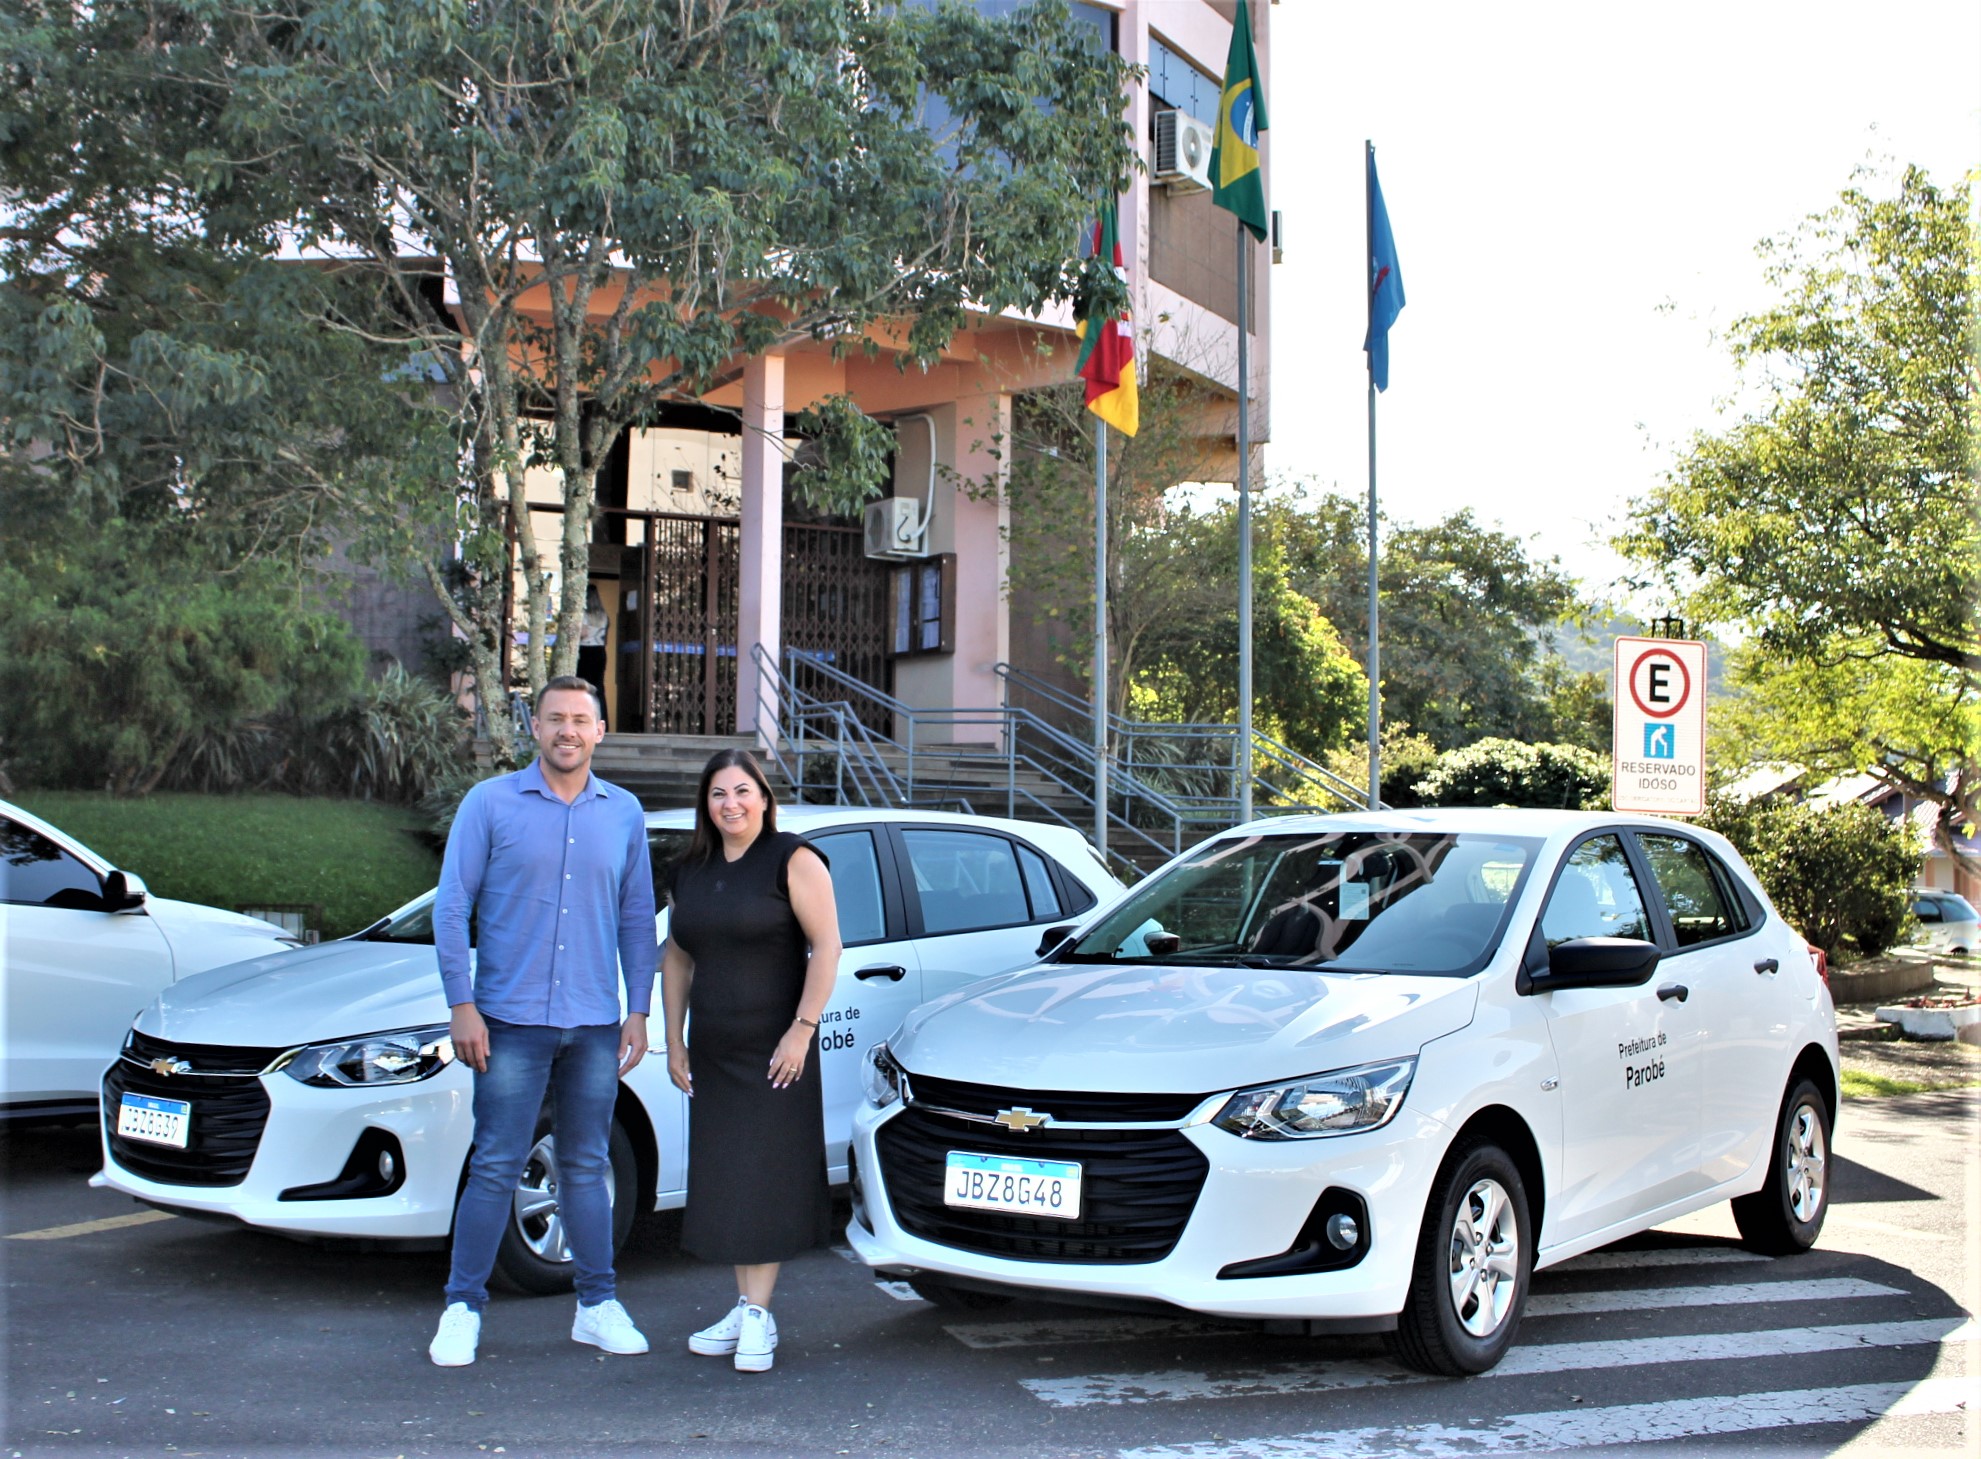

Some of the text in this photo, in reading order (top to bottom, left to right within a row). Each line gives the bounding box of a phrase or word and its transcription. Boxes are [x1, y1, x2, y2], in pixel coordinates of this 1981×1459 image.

[1649, 663, 1671, 703] E
[1621, 761, 1696, 777] RESERVADO
[845, 1006, 861, 1020] de
[1618, 1030, 1667, 1059] Prefeitura de
[1626, 1054, 1665, 1090] Parobé
[956, 1171, 1063, 1208] JBZ8G48
